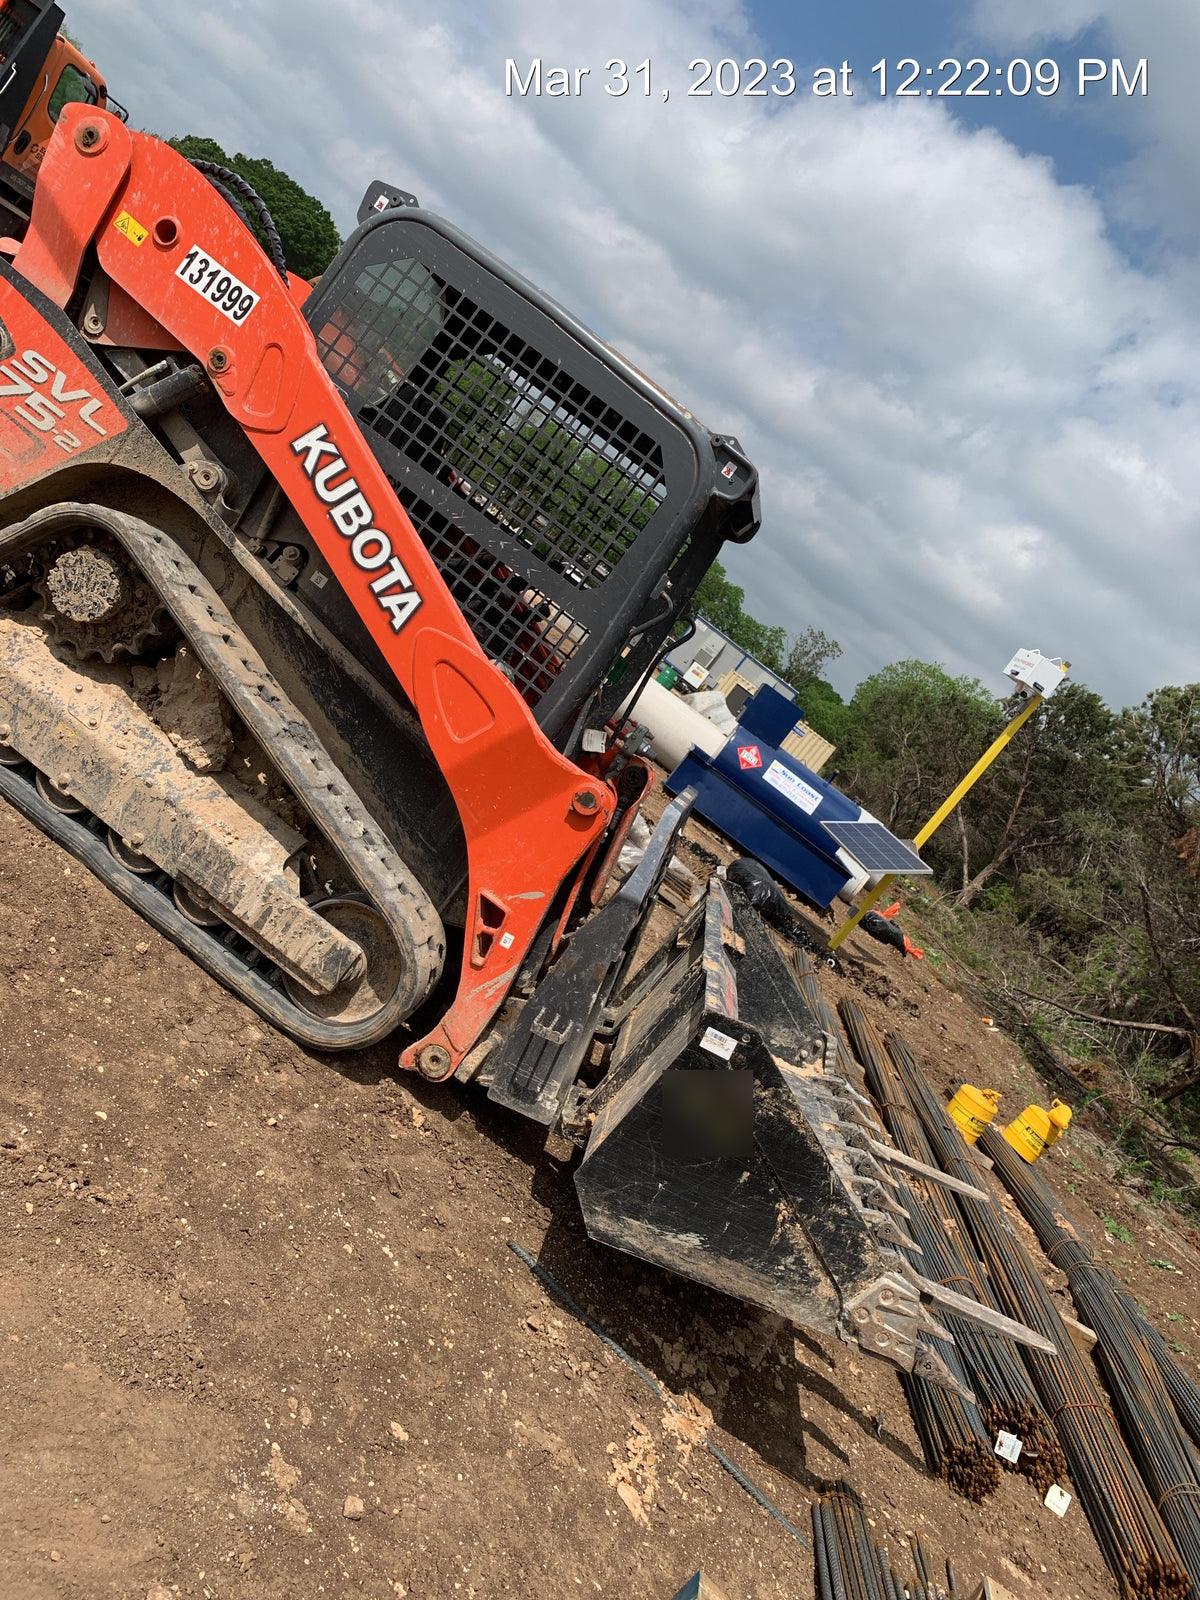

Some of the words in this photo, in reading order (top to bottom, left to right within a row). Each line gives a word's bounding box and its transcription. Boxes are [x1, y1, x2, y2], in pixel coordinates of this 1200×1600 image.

[180, 250, 254, 320] 131999
[10, 349, 107, 437] SVL
[291, 422, 423, 633] KUBOTA
